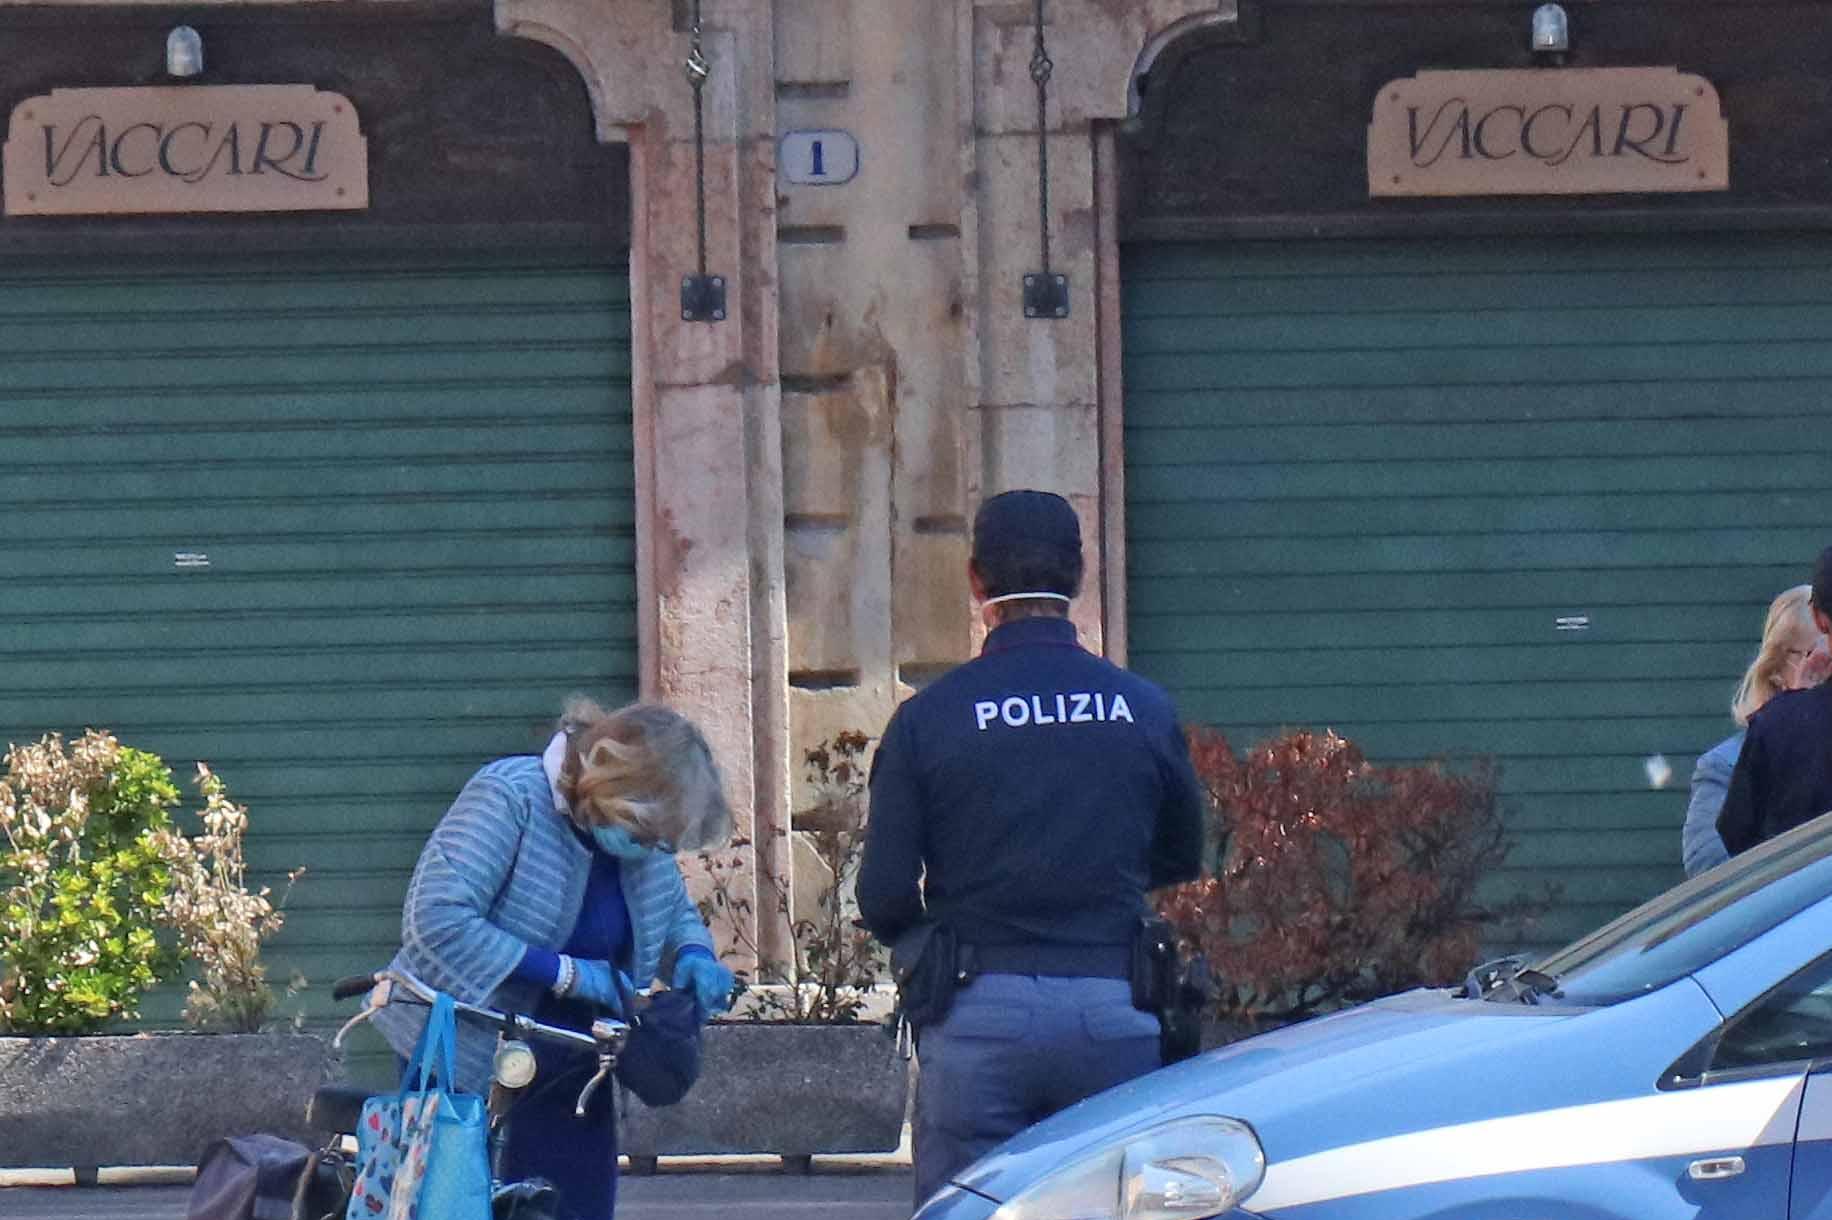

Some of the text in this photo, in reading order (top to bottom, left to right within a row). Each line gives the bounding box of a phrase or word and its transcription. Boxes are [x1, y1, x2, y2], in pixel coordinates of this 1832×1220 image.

[41, 114, 330, 188] VACCARI
[809, 140, 828, 176] 1
[1405, 97, 1690, 167] VACCARI
[974, 693, 1134, 731] POLIZIA
